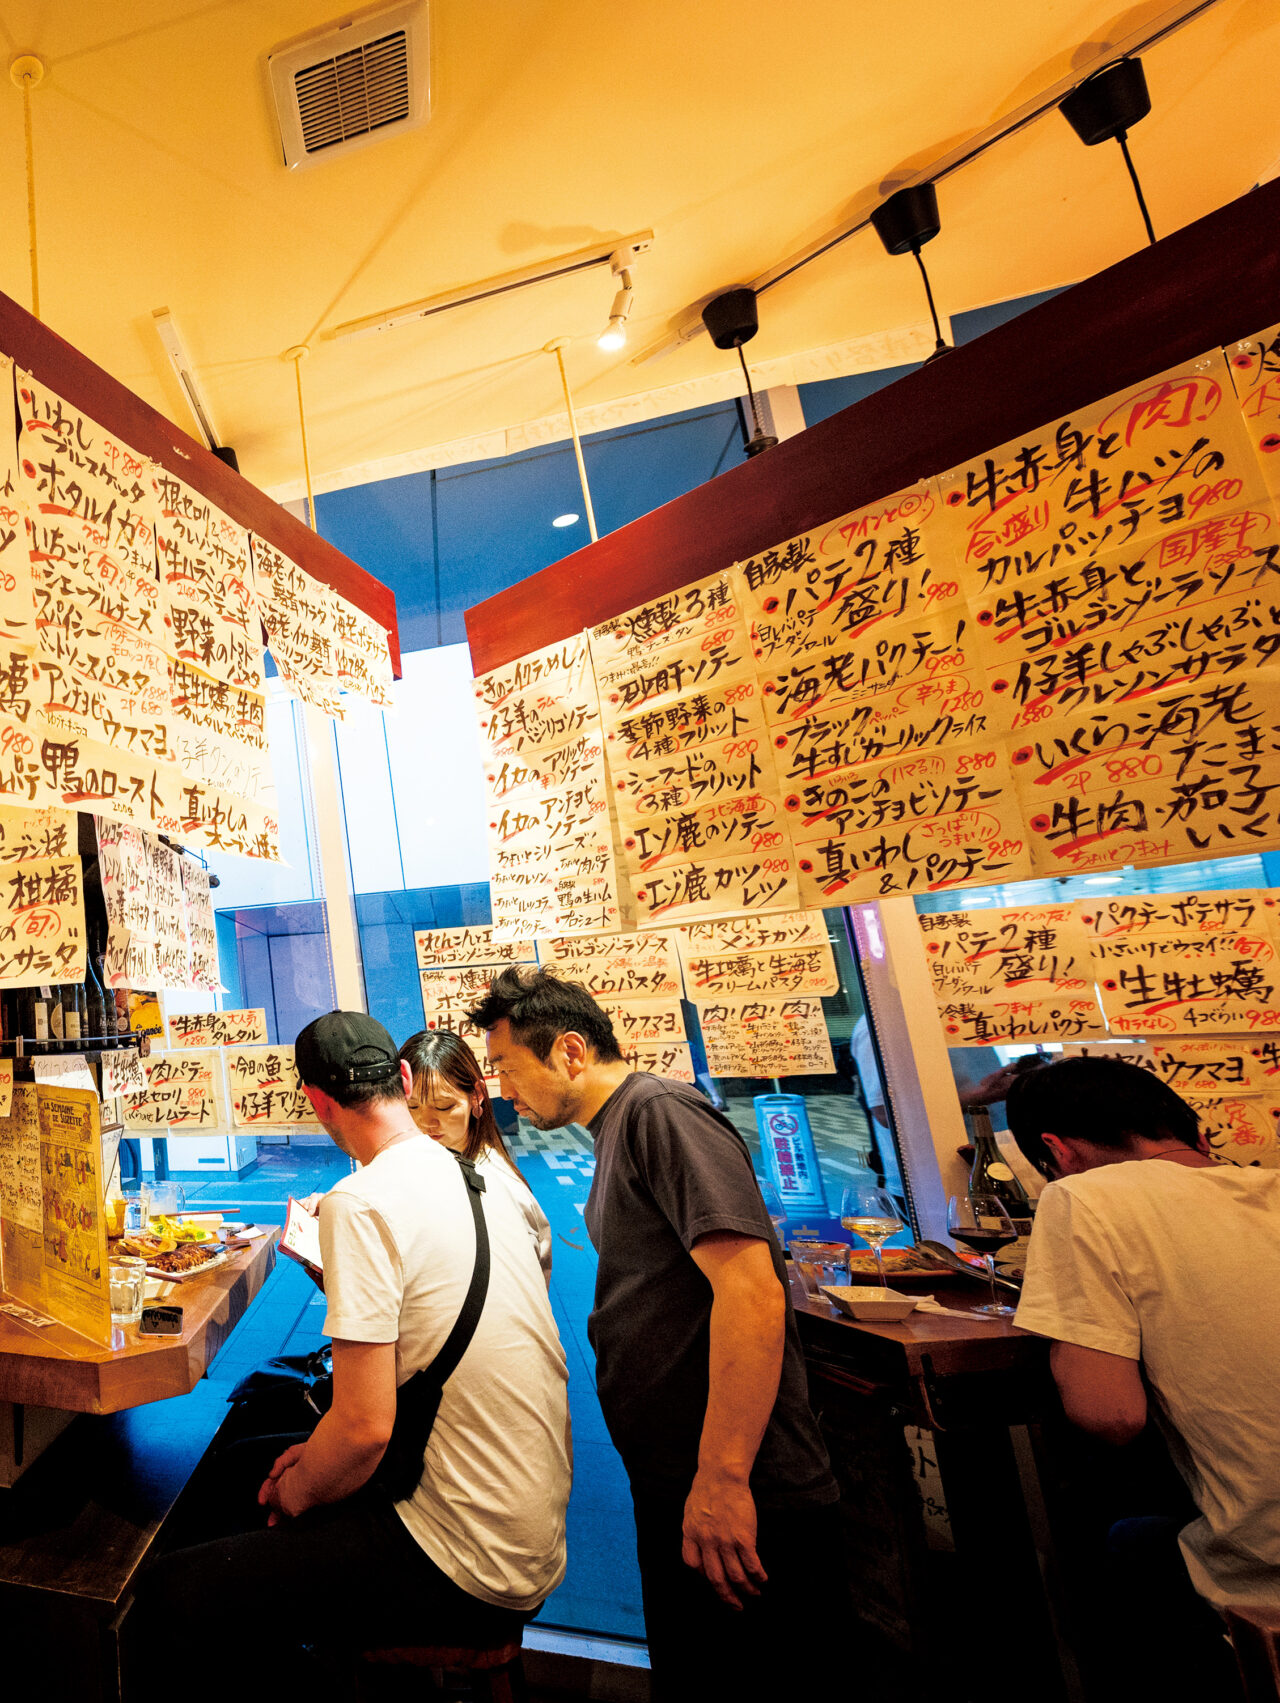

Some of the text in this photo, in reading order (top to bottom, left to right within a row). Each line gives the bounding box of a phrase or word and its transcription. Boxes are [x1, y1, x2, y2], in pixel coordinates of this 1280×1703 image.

[966, 420, 1123, 513] 牛赤身と
[1186, 477, 1244, 521] 980
[976, 492, 1186, 596] カルパッチョ
[136, 577, 159, 600] 980
[922, 580, 960, 613] 980
[704, 604, 736, 629] 880
[700, 628, 735, 652] 680
[924, 652, 966, 679] 980
[616, 645, 743, 714] 砂肝ソテー
[723, 684, 755, 706] 880
[0, 725, 34, 756] 980
[722, 739, 759, 764] 980
[954, 751, 998, 775] 880
[1105, 753, 1163, 784] 880
[40, 738, 165, 821] 鴨のロースト
[750, 831, 784, 853] 980
[986, 839, 1023, 861] 980
[762, 858, 790, 879] 980
[1199, 920, 1225, 932] 680
[1054, 977, 1088, 993] 980
[1118, 958, 1275, 1009] 生牡蠣
[1068, 999, 1097, 1015] 980
[1194, 1079, 1218, 1090] 680
[51, 1102, 74, 1116] SEMAINE
[60, 1114, 83, 1127] SUZETTE
